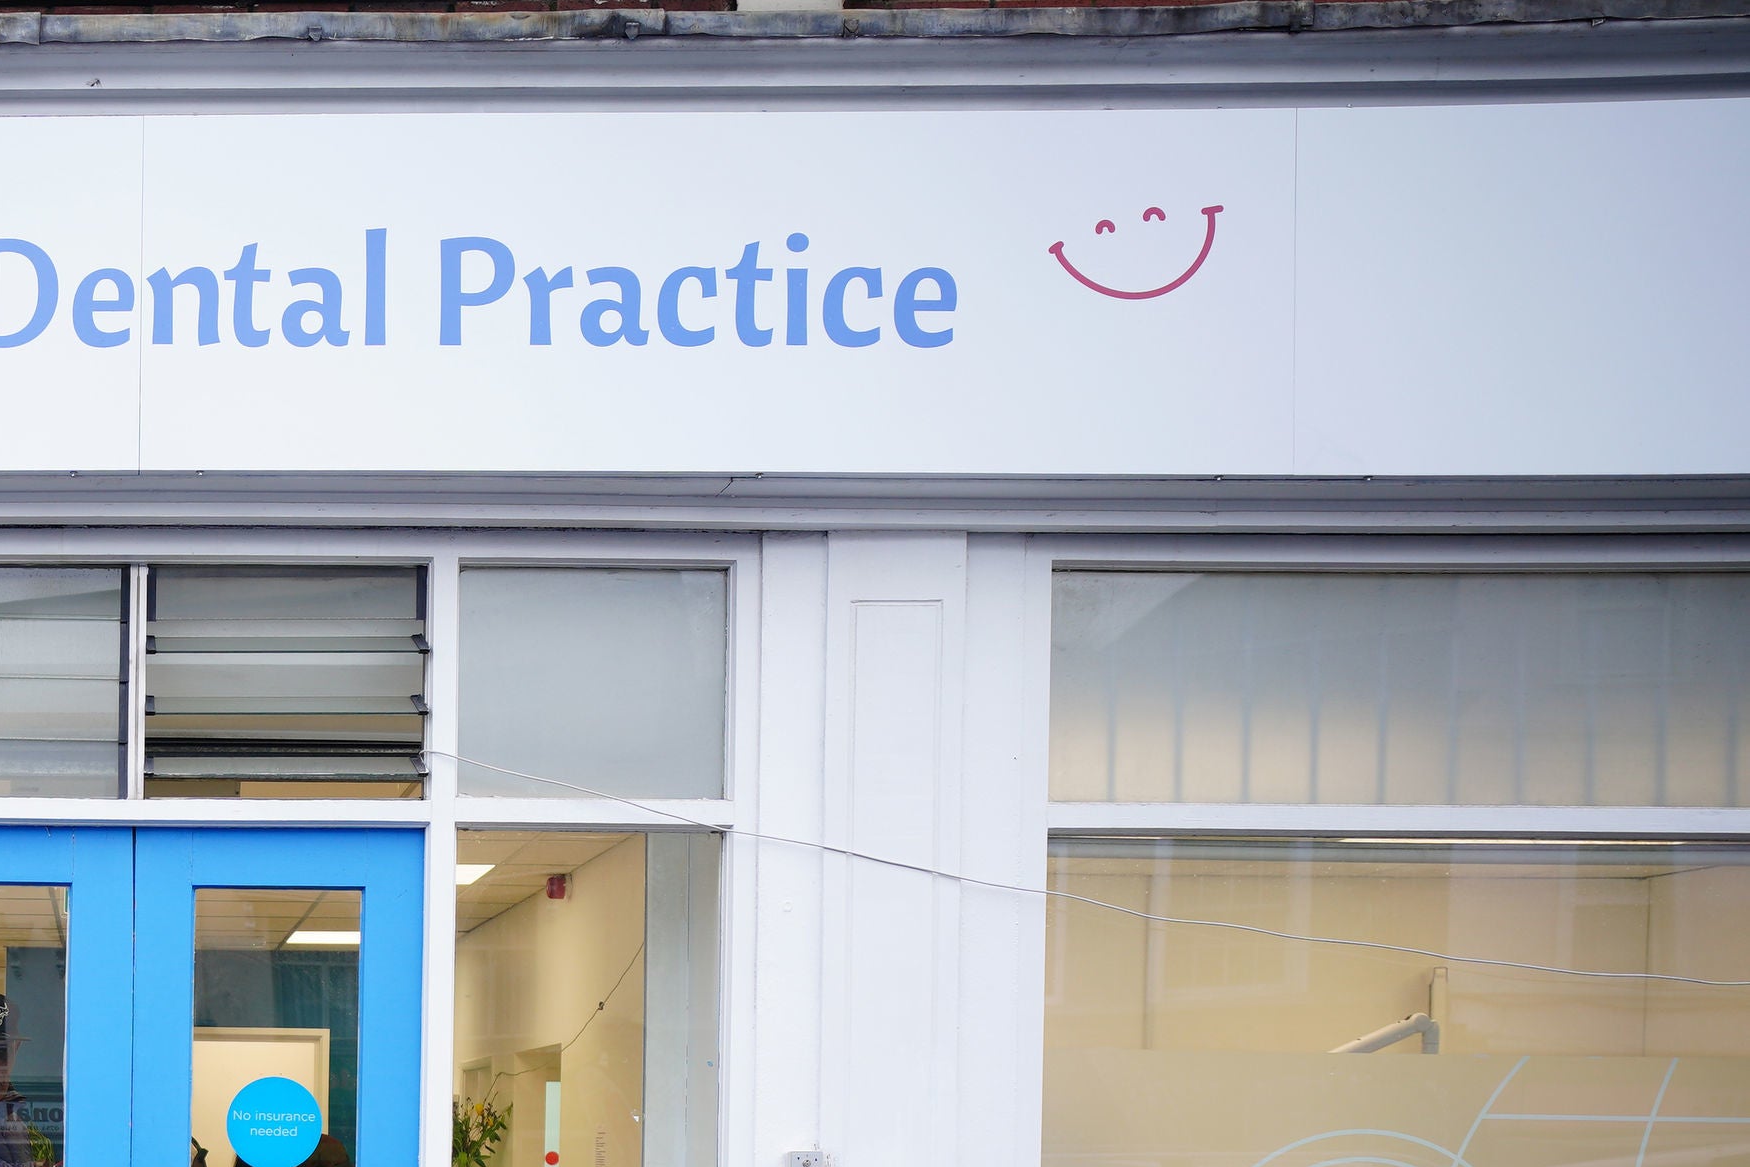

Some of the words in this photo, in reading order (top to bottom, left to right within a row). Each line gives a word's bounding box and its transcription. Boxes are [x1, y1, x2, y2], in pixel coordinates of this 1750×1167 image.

[439, 233, 958, 349] Practice
[233, 1110, 251, 1120] No
[255, 1110, 316, 1122] insurance
[250, 1126, 298, 1136] needed
